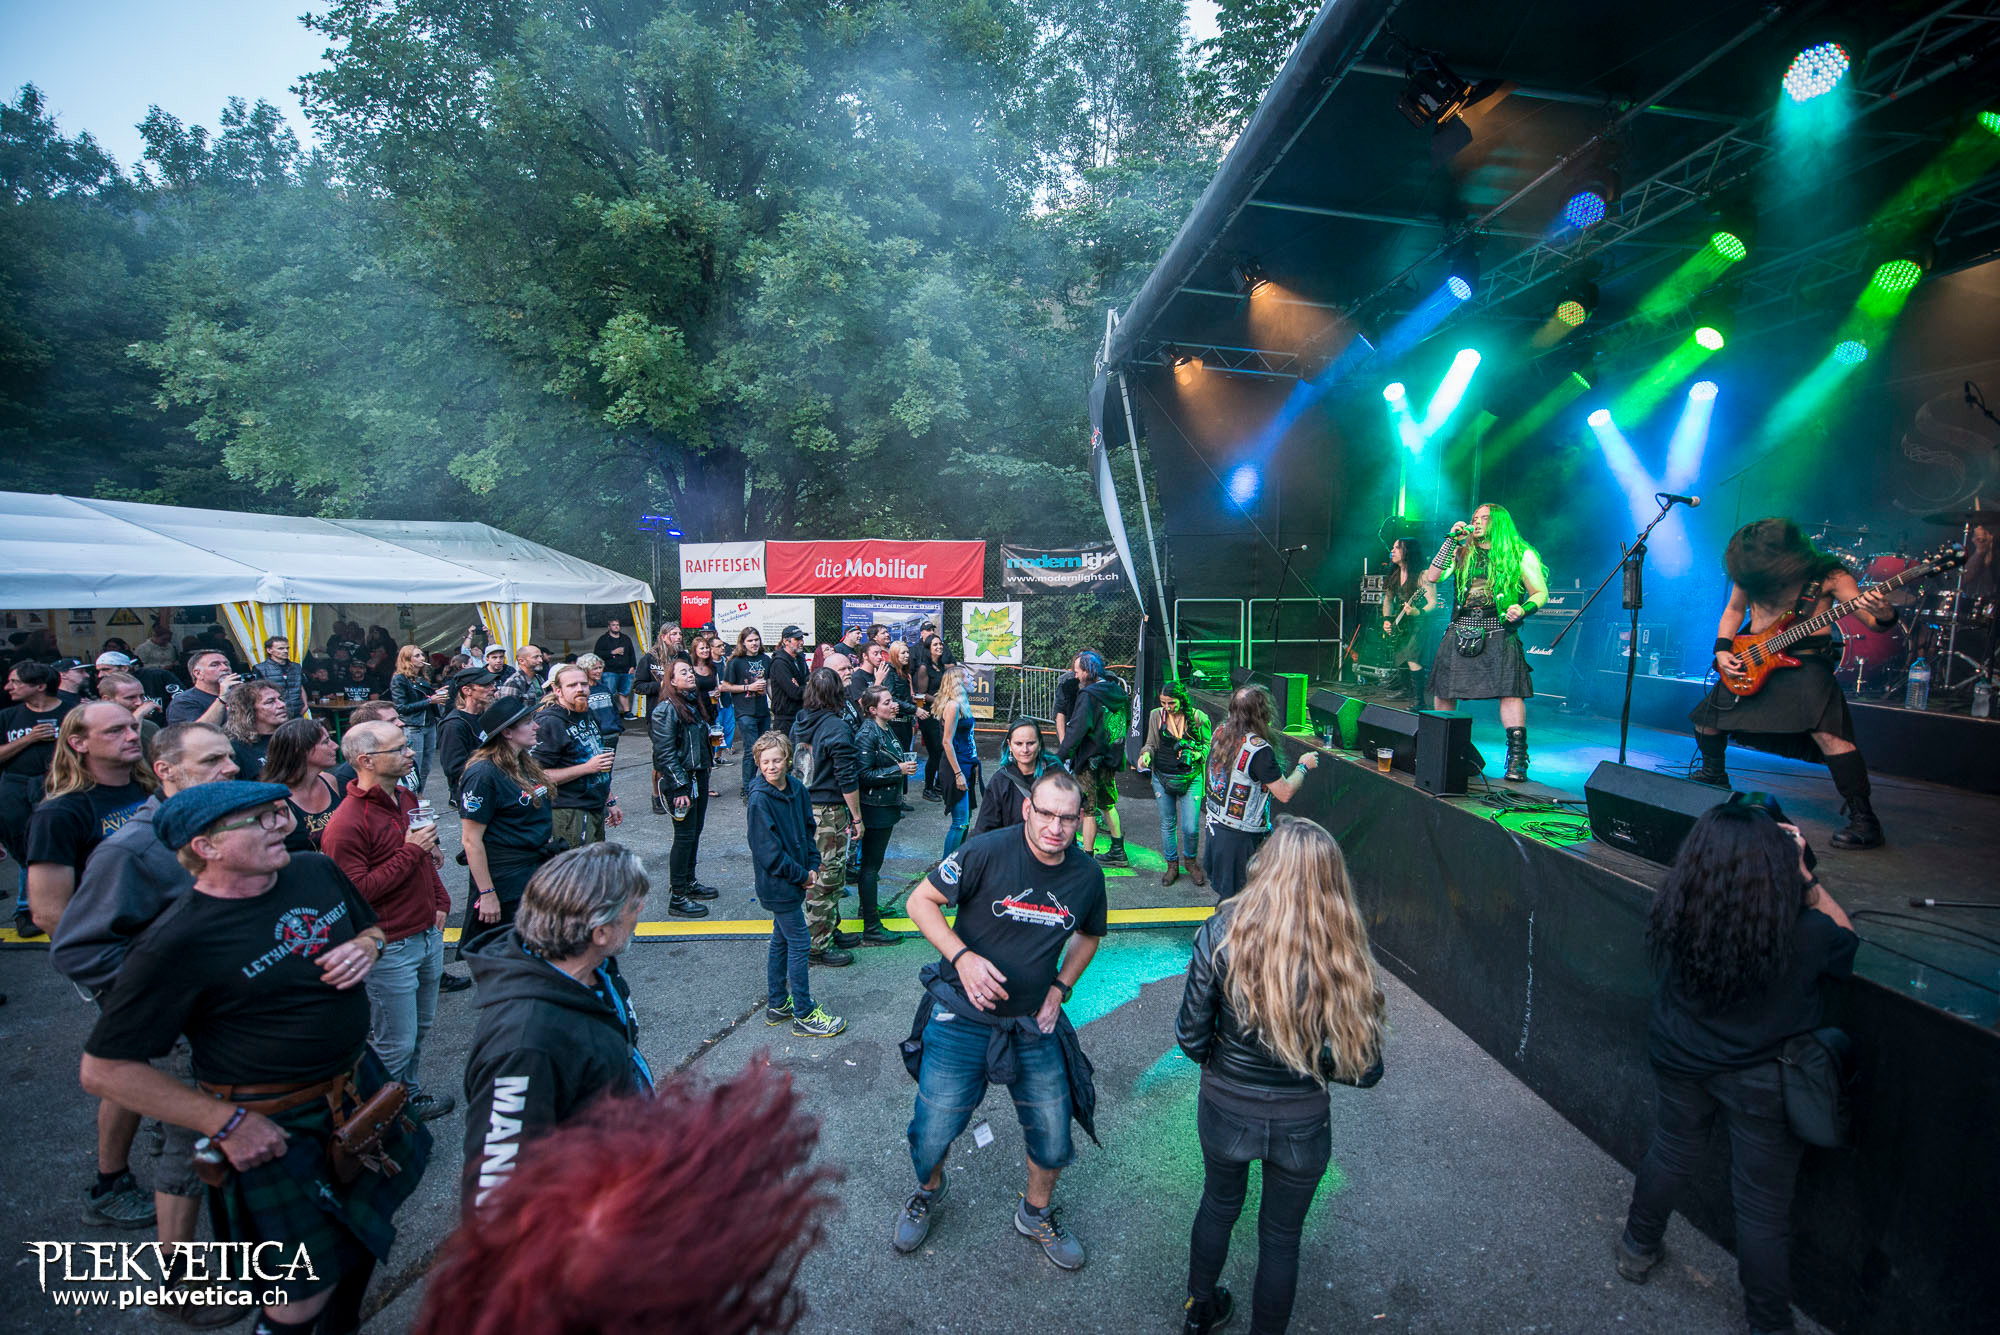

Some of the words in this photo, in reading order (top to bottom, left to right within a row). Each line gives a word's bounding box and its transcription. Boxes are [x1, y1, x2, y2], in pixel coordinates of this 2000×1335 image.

[685, 557, 760, 573] RAIFFEISEN
[815, 558, 842, 578] die
[845, 558, 928, 579] Mobiliar
[1007, 572, 1119, 583] www.modernlight.ch
[682, 596, 710, 606] Frutiger
[1526, 645, 1554, 655] Marshall
[242, 942, 294, 978] LETHAL
